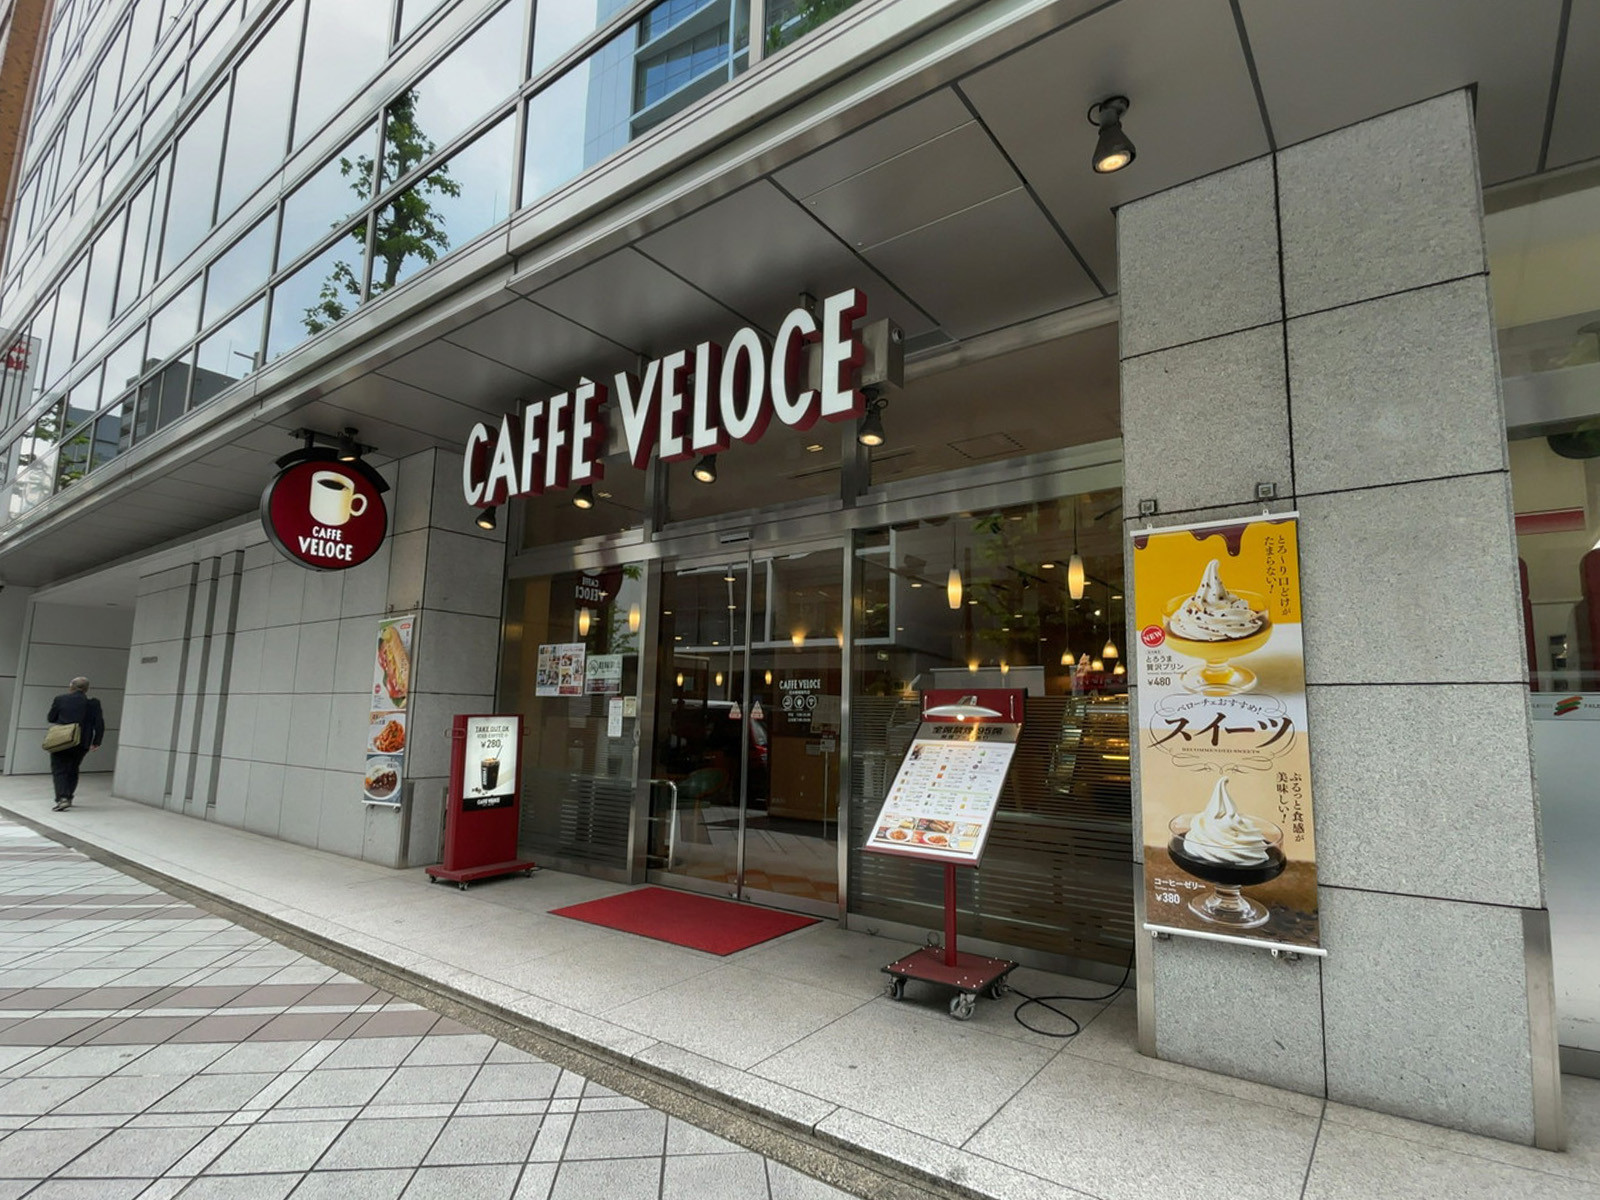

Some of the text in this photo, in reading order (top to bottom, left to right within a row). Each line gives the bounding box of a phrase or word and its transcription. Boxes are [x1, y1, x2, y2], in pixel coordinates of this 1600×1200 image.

[615, 288, 857, 468] VELOCE
[312, 526, 342, 541] CAFFE
[298, 535, 353, 561] VELOCE
[1143, 631, 1162, 642] NEW
[1146, 655, 1172, 663] とろうま
[1147, 712, 1293, 749] スイーツ
[1154, 878, 1206, 890] コーヒーゼリー
